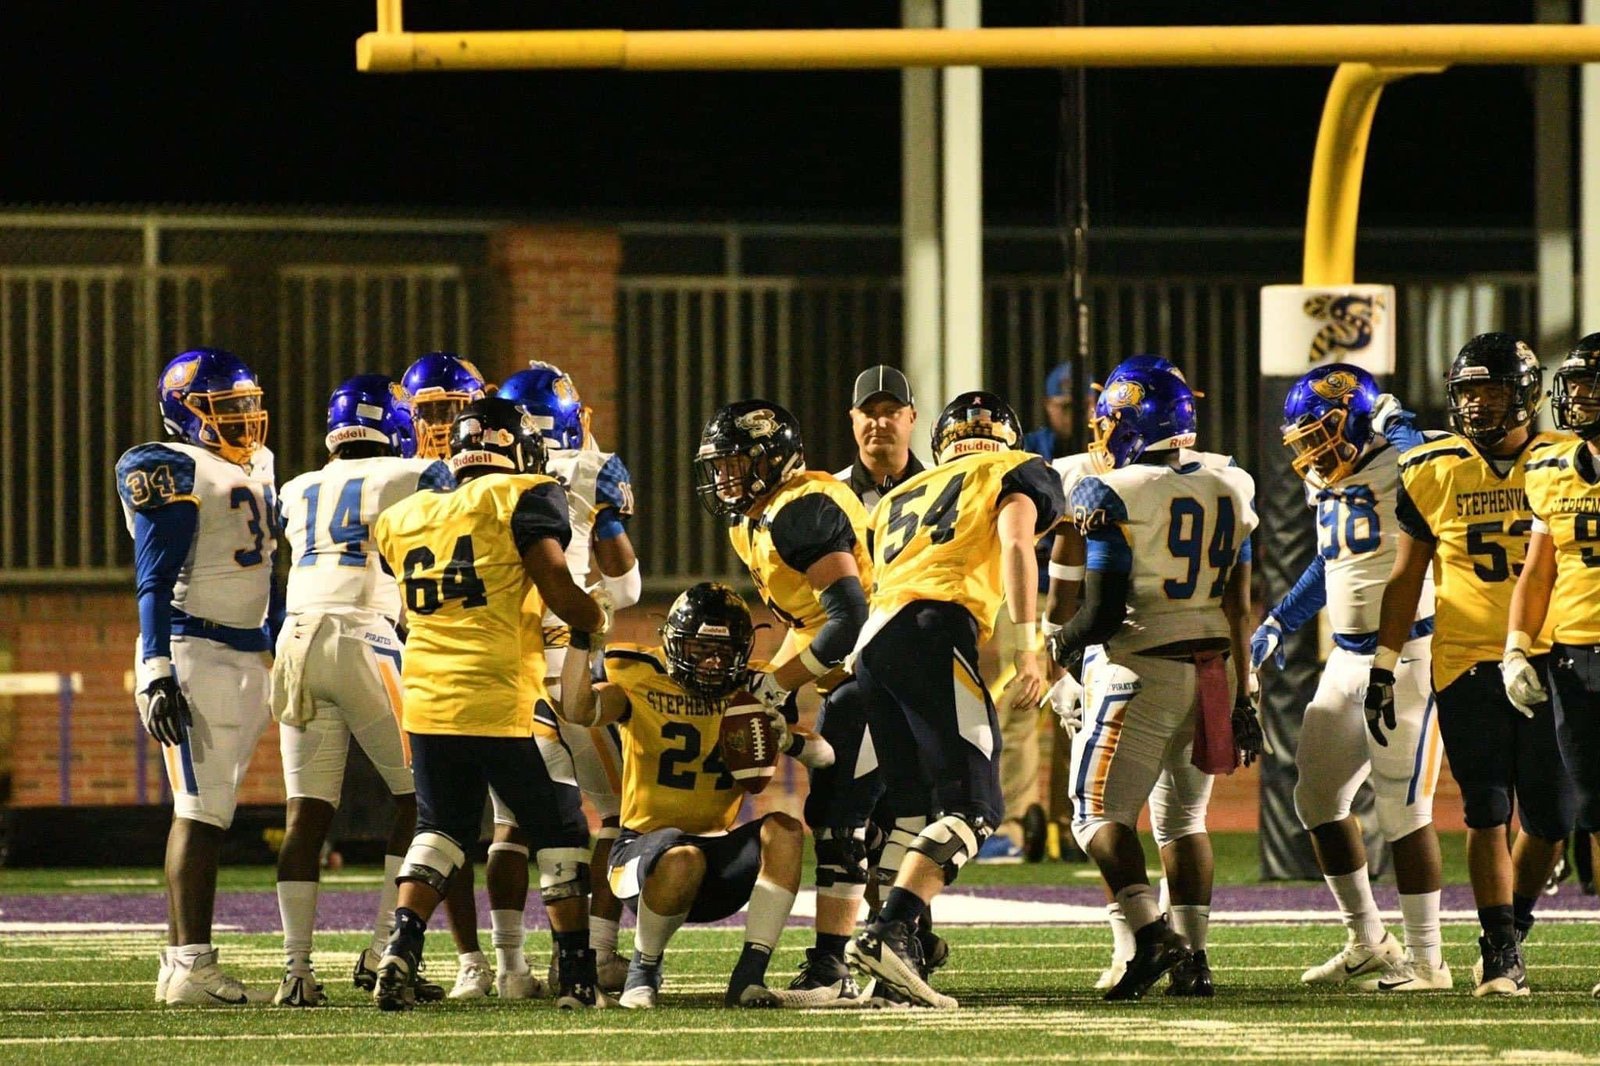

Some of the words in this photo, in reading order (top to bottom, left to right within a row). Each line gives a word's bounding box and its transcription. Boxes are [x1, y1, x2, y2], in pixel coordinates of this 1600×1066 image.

[328, 427, 367, 444] Riddell
[452, 452, 493, 468] Riddell
[954, 441, 1000, 455] Riddell
[125, 464, 176, 506] 34
[299, 476, 370, 568] 14
[883, 471, 968, 565] 54
[403, 533, 488, 616] 64
[1163, 495, 1236, 600] 94
[364, 631, 392, 646] PIRATES
[656, 720, 735, 791] 24
